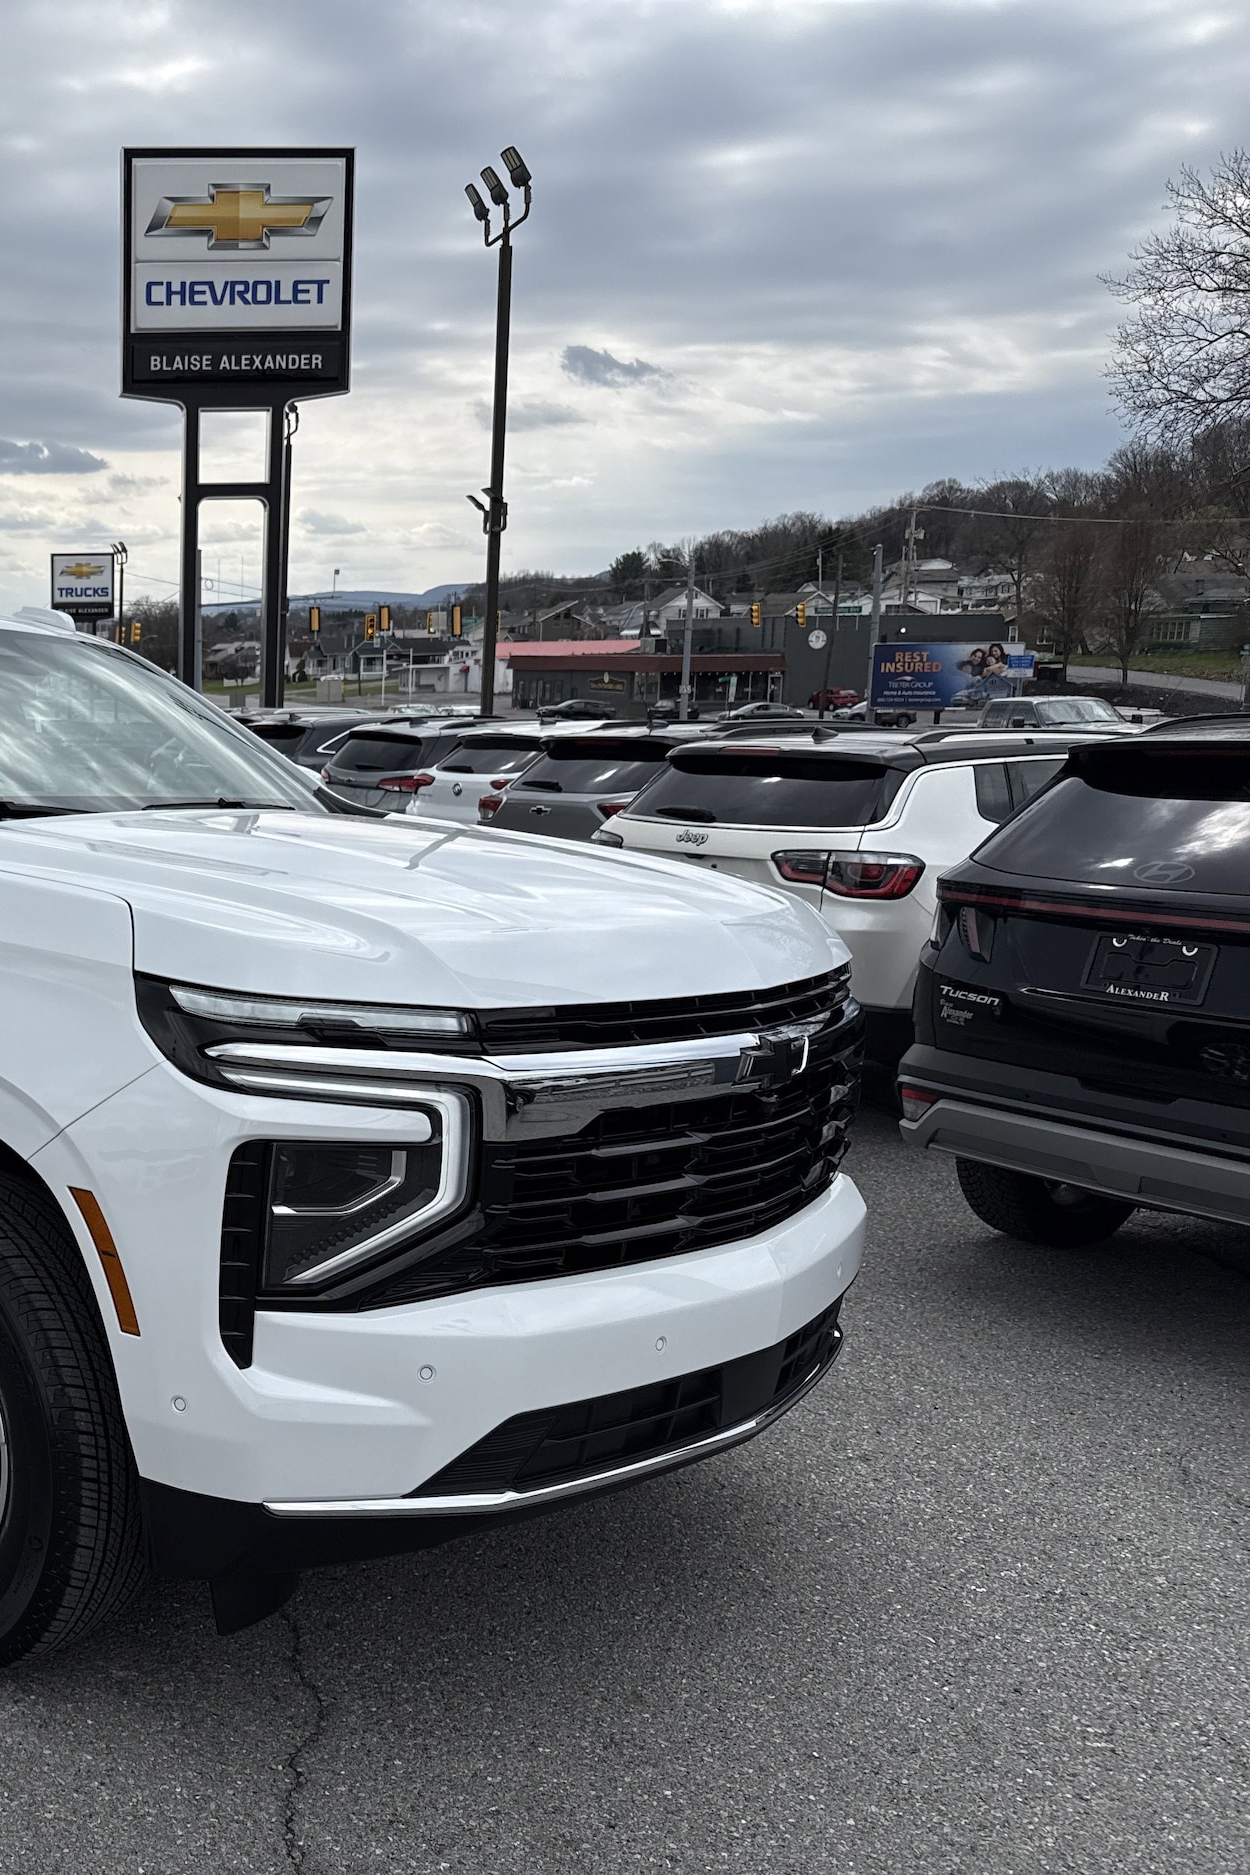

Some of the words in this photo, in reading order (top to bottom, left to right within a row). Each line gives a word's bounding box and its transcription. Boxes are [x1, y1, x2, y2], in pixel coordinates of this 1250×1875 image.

[145, 280, 330, 306] CHEVROLET
[150, 355, 212, 371] BLAISE
[219, 354, 323, 370] ALEXANDER
[57, 587, 109, 598] TRUCKS
[895, 651, 929, 662] REST
[880, 661, 942, 673] INSURED
[676, 829, 709, 847] Jeep
[1106, 983, 1170, 1002] ALEXANDER
